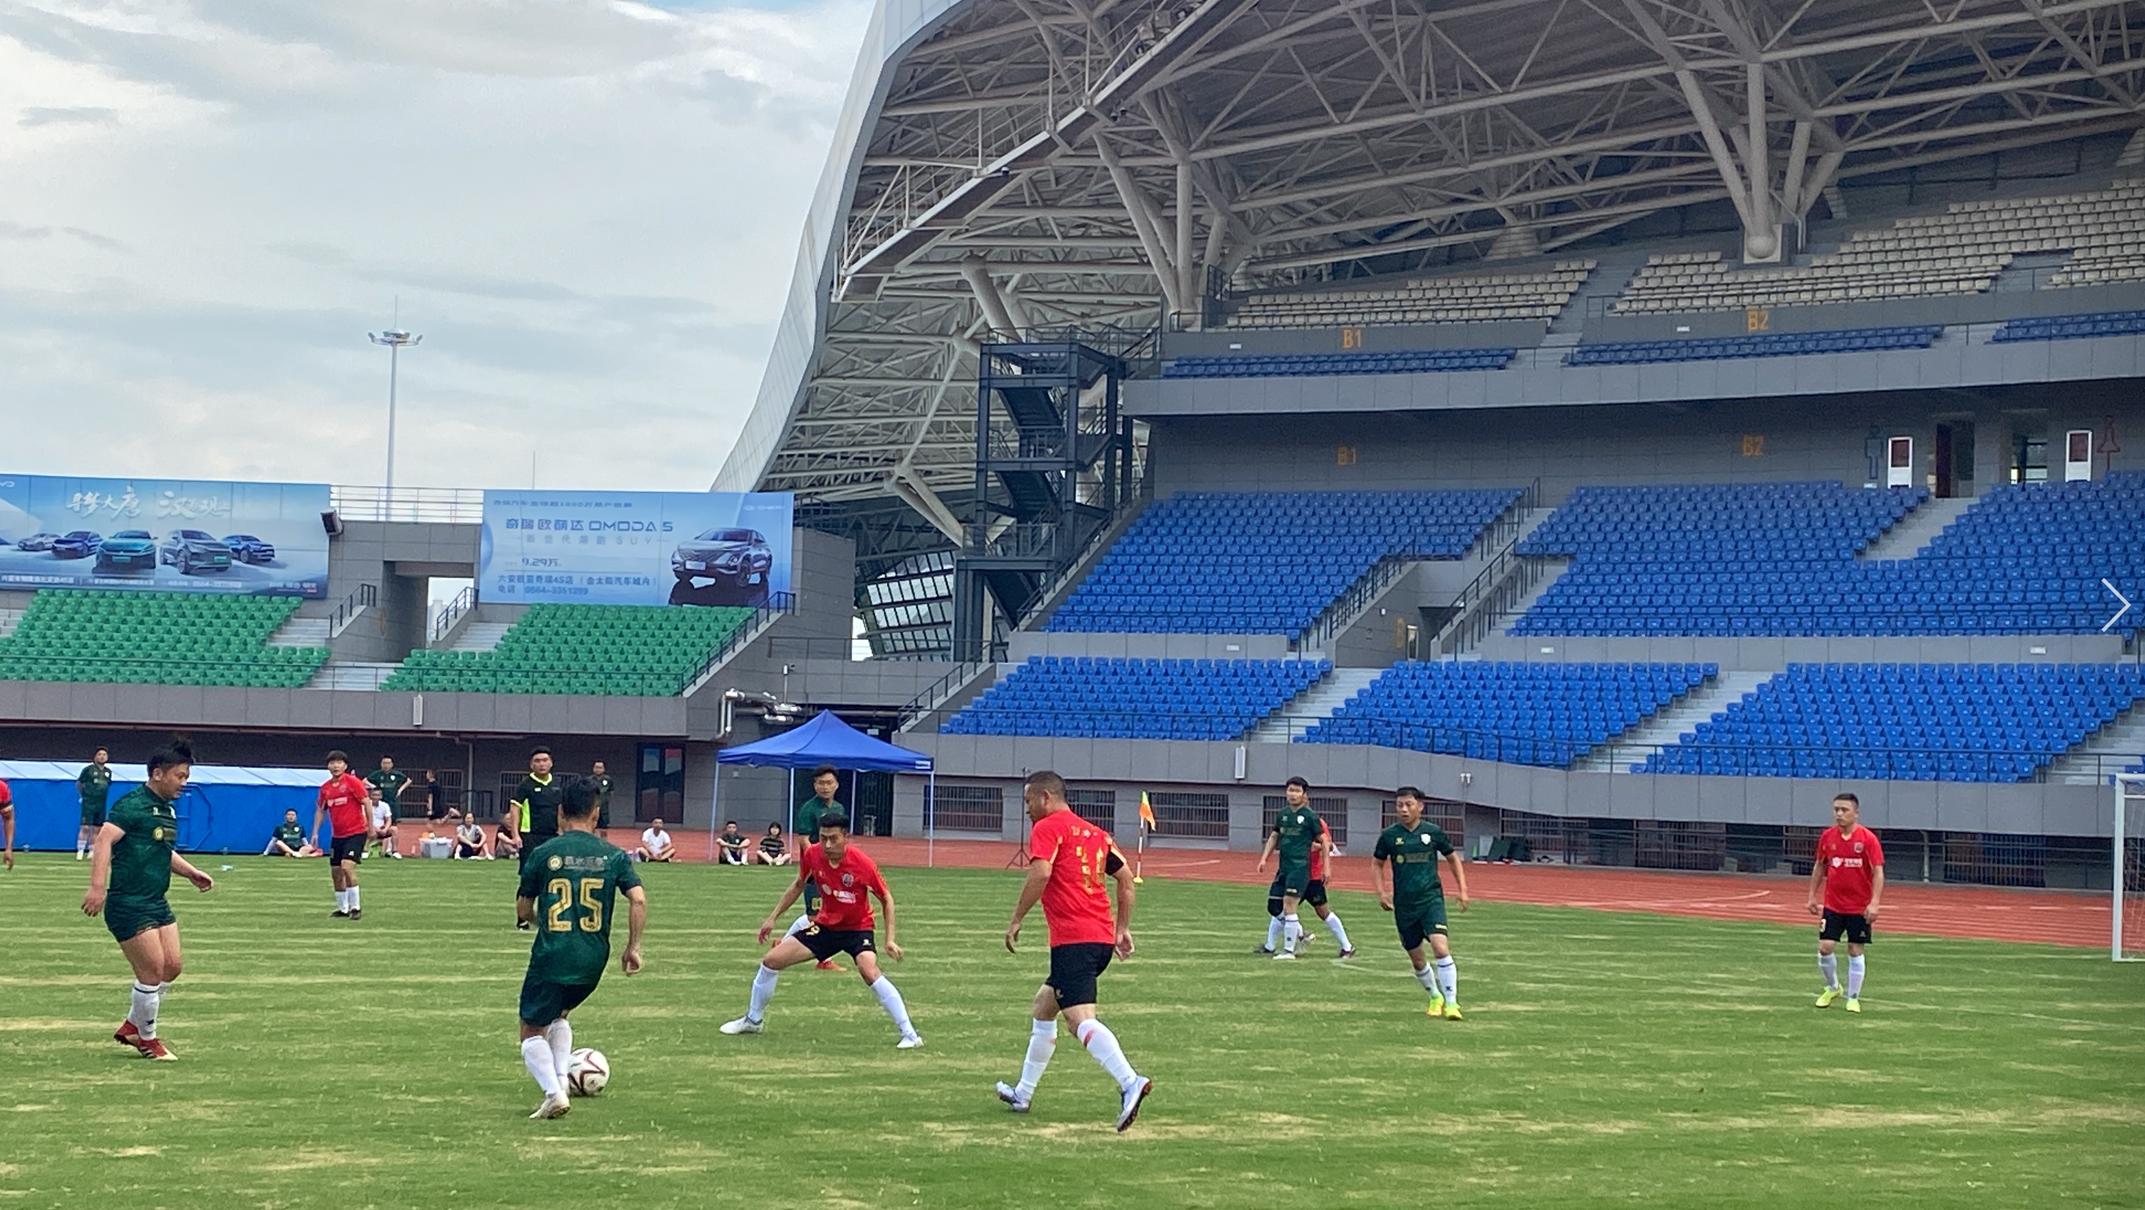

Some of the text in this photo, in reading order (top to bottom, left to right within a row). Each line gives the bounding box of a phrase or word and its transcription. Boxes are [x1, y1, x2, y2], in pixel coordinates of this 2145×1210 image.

[1748, 310, 1769, 330] B2
[1343, 328, 1361, 348] B1
[588, 520, 657, 532] OMODA
[548, 878, 604, 931] 25
